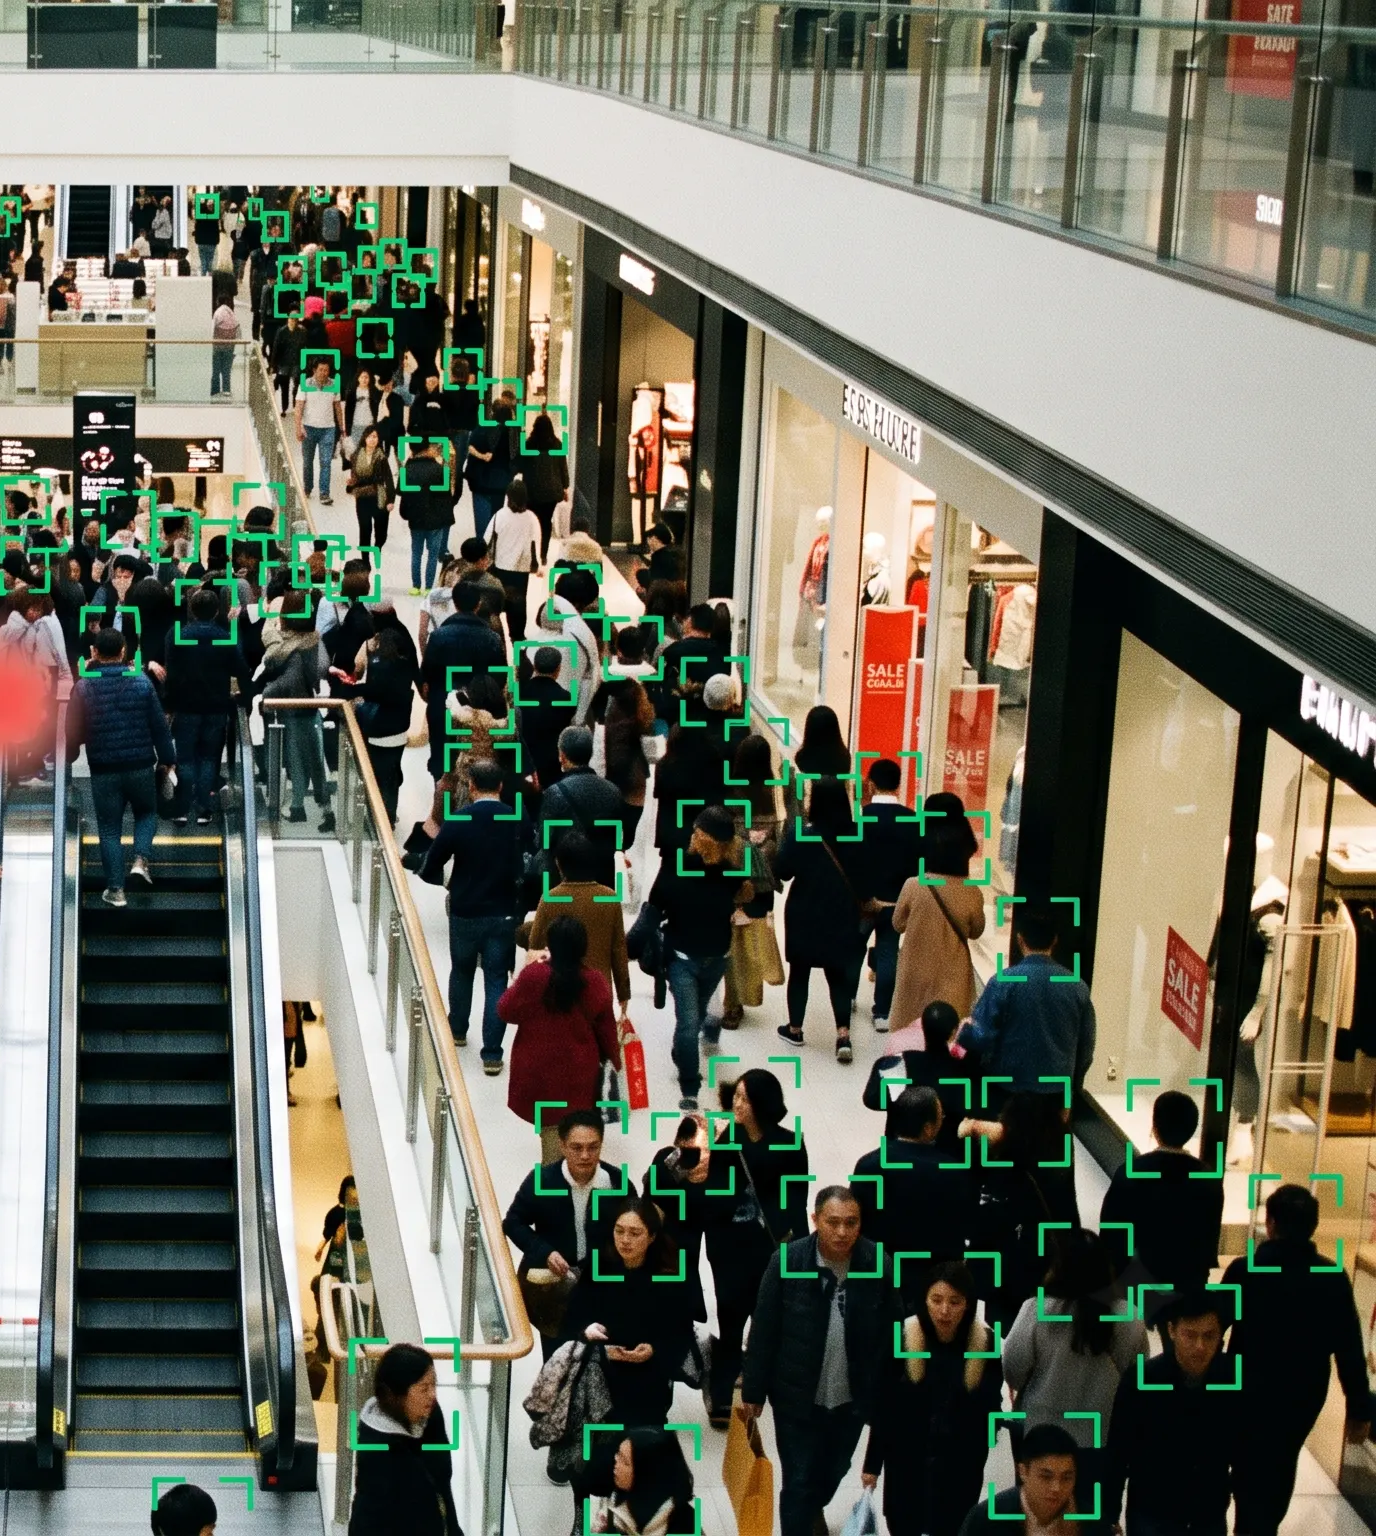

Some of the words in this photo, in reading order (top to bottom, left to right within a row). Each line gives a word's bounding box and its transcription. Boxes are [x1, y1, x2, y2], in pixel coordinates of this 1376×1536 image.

[867, 664, 905, 678] SALE
[945, 749, 985, 766] SALE
[1167, 958, 1200, 1016] SALE
